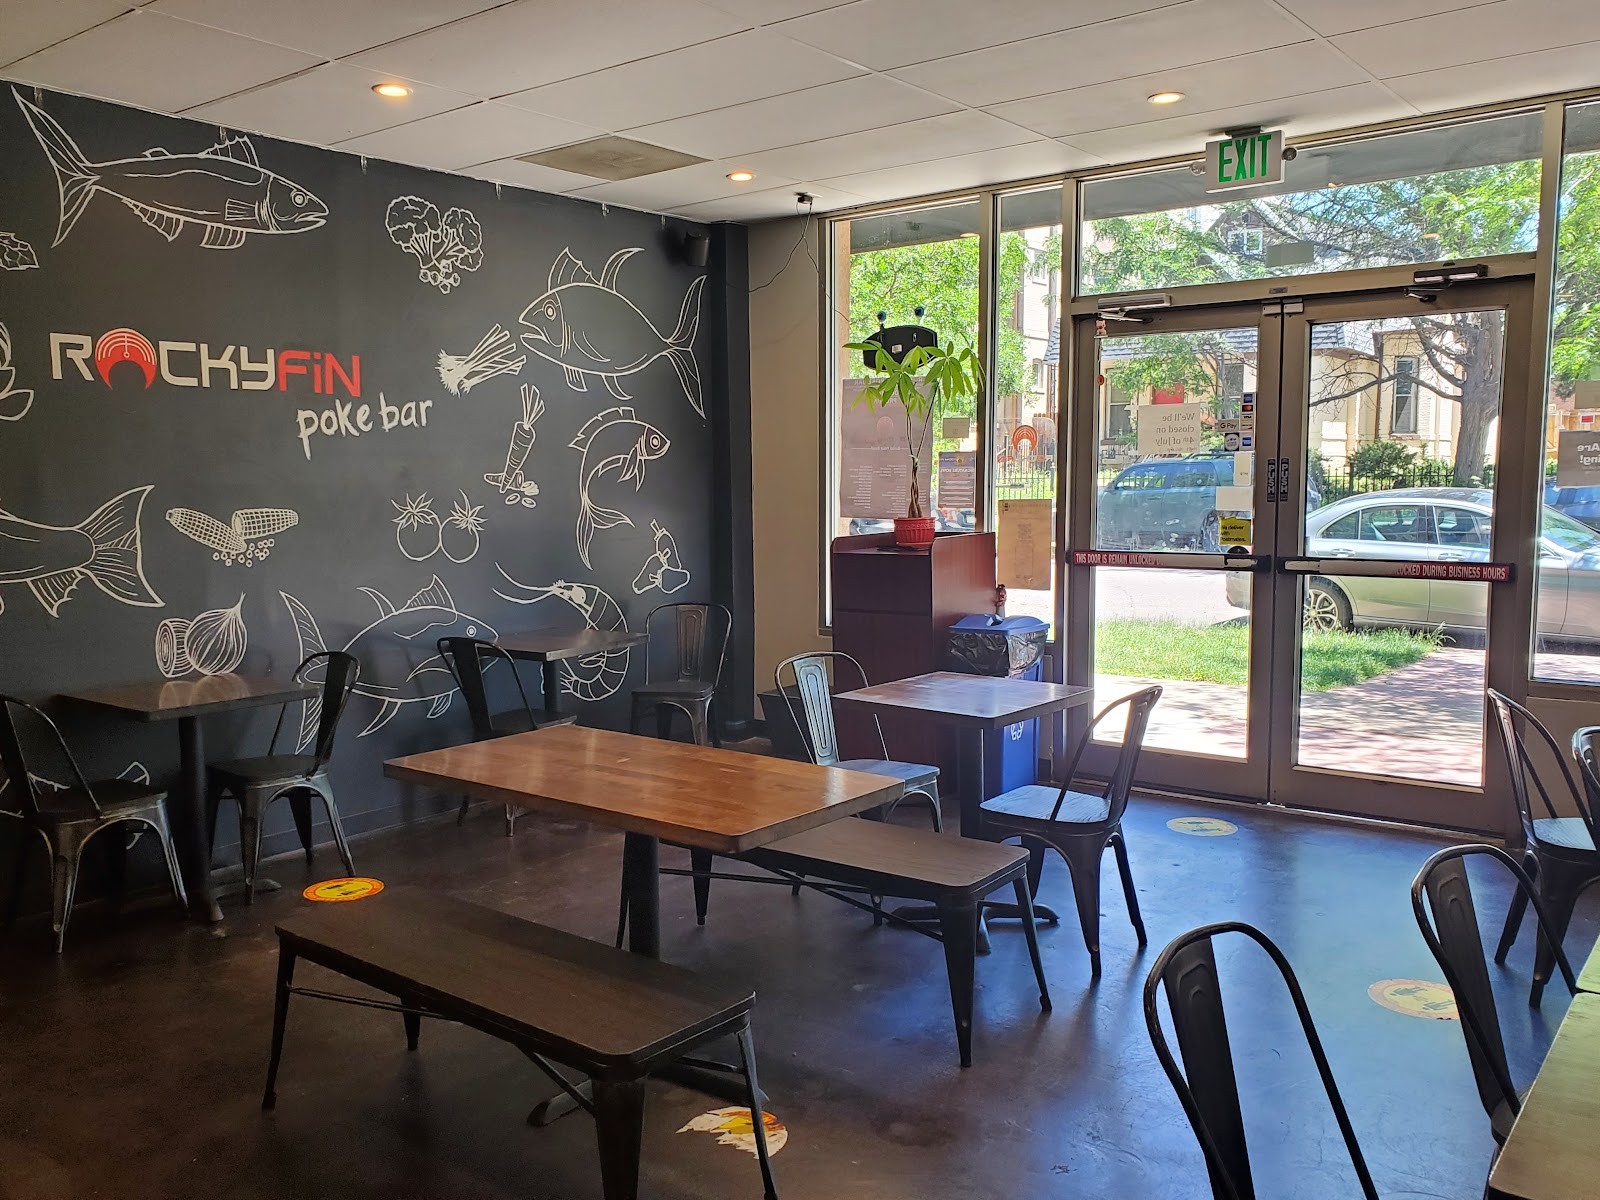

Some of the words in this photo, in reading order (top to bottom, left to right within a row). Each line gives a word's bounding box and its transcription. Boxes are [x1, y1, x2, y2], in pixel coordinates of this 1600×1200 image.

[1218, 134, 1272, 183] EXIT
[296, 398, 374, 461] poke
[379, 392, 433, 433] bar
[1267, 464, 1276, 494] PUSH
[1280, 463, 1289, 493] PUSH
[1075, 553, 1087, 564] THIS
[1087, 553, 1101, 564] DOOR
[1108, 553, 1128, 565] REMAIN
[1422, 564, 1447, 577] DURING
[1448, 565, 1481, 578] BUSINESS
[1482, 566, 1506, 580] HOURS
